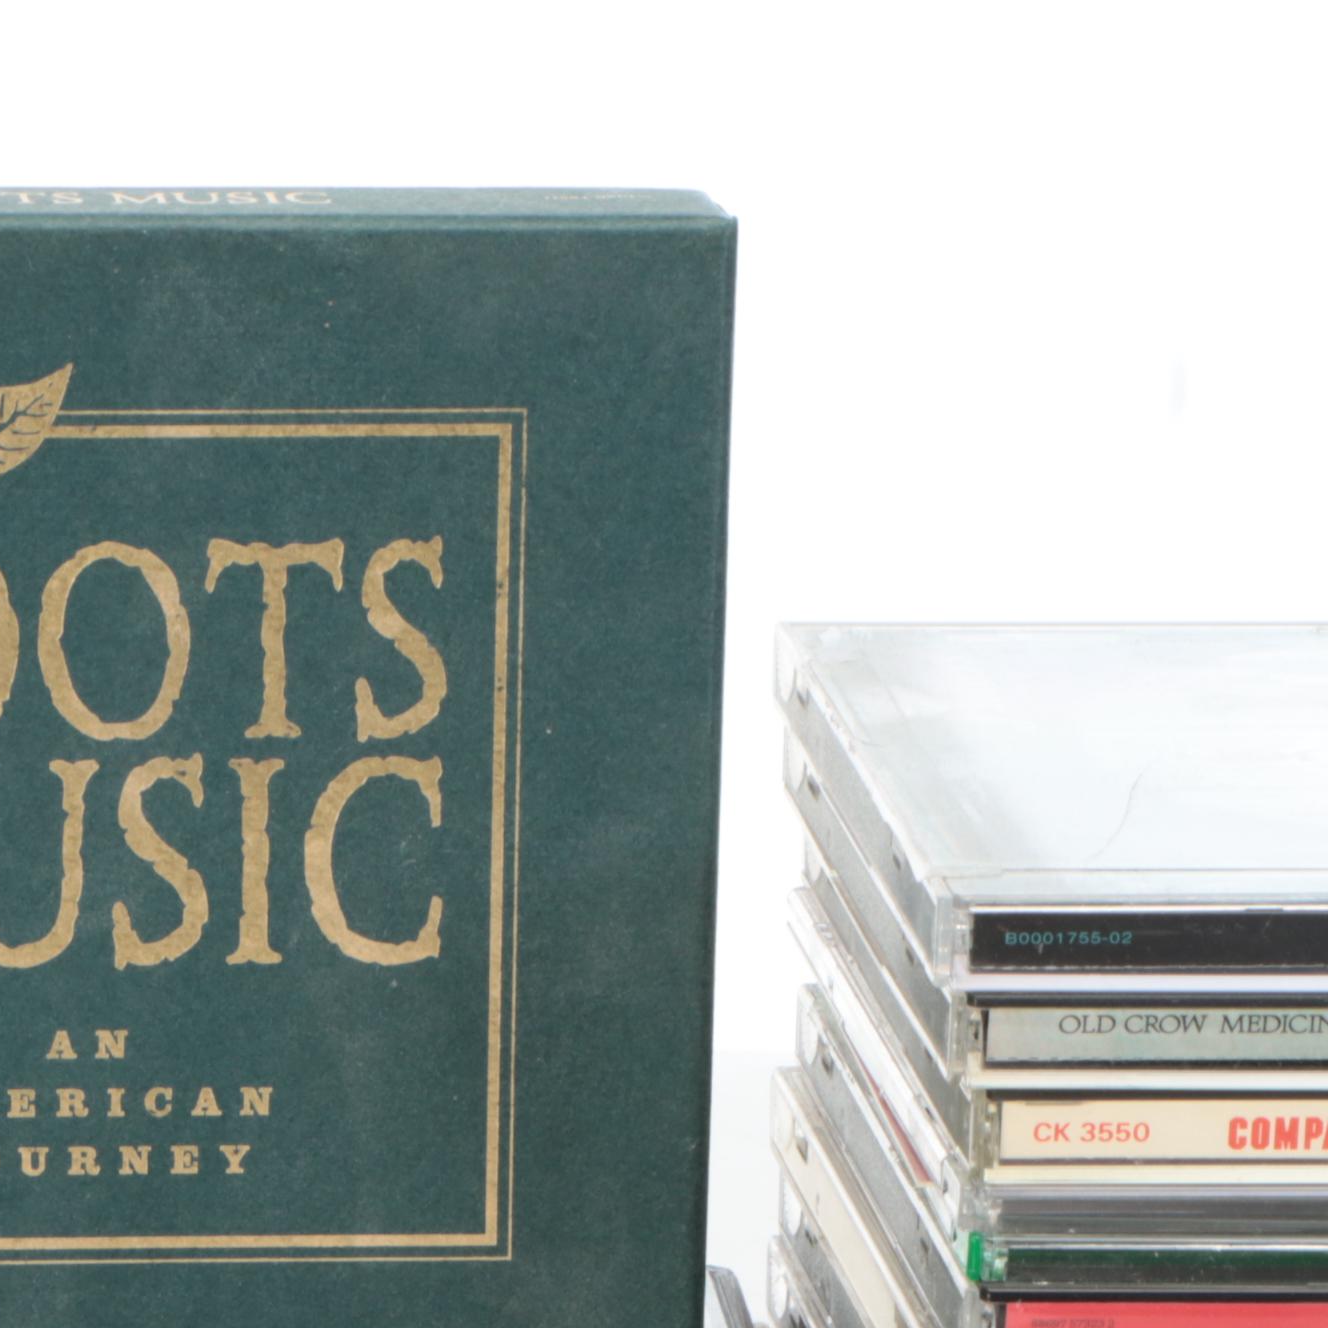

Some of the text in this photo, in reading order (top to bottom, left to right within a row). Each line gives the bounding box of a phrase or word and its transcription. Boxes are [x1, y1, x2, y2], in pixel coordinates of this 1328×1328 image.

[112, 190, 333, 205] MUSIC
[1004, 931, 1133, 946] B0001755-02
[1058, 1013, 1117, 1035] OLD
[1124, 1013, 1209, 1035] CROW
[45, 1029, 128, 1060] AN
[1032, 1121, 1151, 1143] CK 3550
